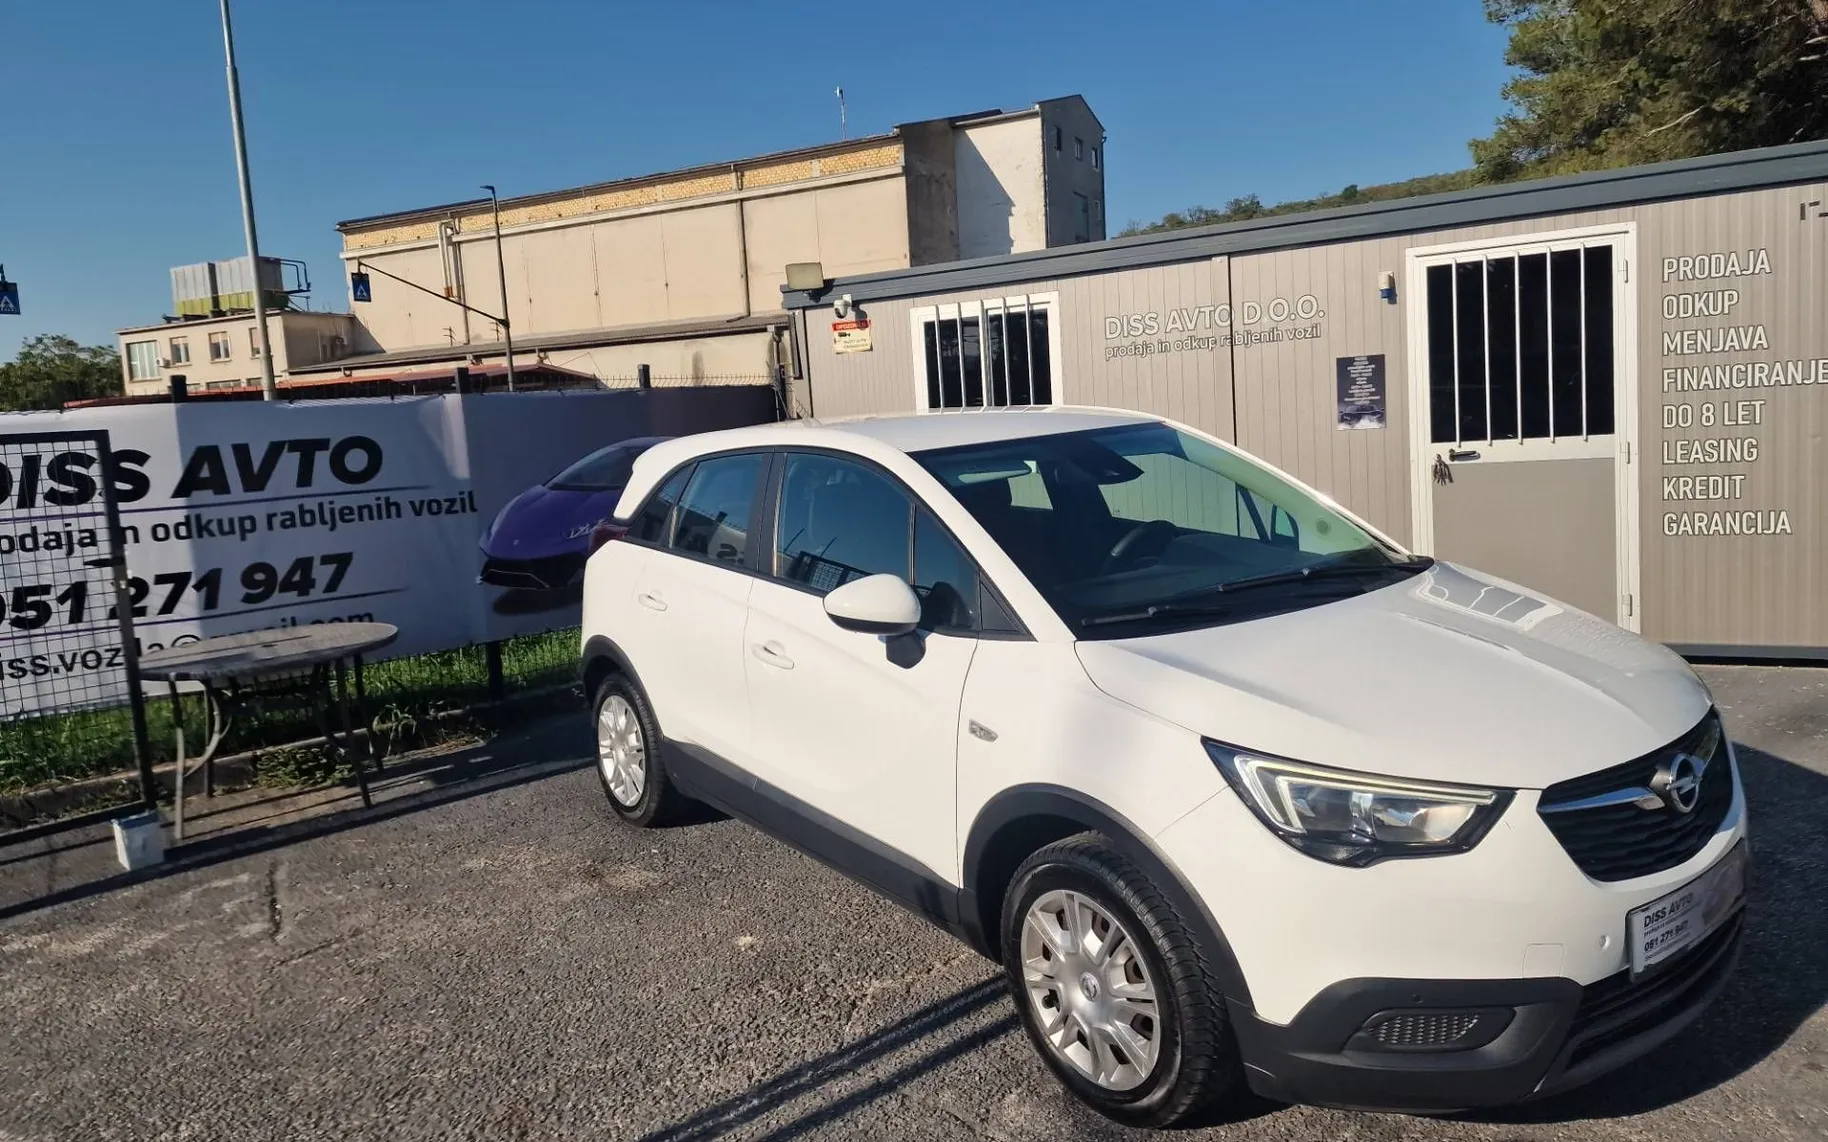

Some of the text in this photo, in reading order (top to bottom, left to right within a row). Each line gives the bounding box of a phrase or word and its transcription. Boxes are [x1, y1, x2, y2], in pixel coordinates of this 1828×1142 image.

[1662, 248, 1772, 283] PRODAJA
[1104, 312, 1159, 340] DISS
[1165, 303, 1234, 333] AVTO
[1662, 289, 1740, 320] ODKUP
[1105, 323, 1321, 361] prodaja in odkup rabljenih vozil
[1662, 324, 1769, 356] MENJAVA
[1662, 358, 1828, 393] FINANCIRANJE
[1662, 399, 1766, 429] DO 8 LET
[171, 435, 383, 498] AVTO
[1662, 437, 1759, 466] LEASING
[1662, 474, 1746, 501] KREDIT
[119, 523, 140, 545] n
[151, 513, 257, 542] odkup
[267, 496, 402, 532] rabljenih
[410, 491, 478, 517] vozil
[1662, 510, 1793, 537] GARANCIJA
[0, 552, 353, 630] 51 271 947
[1644, 907, 1667, 928] DISS
[1668, 892, 1693, 915] AVTO
